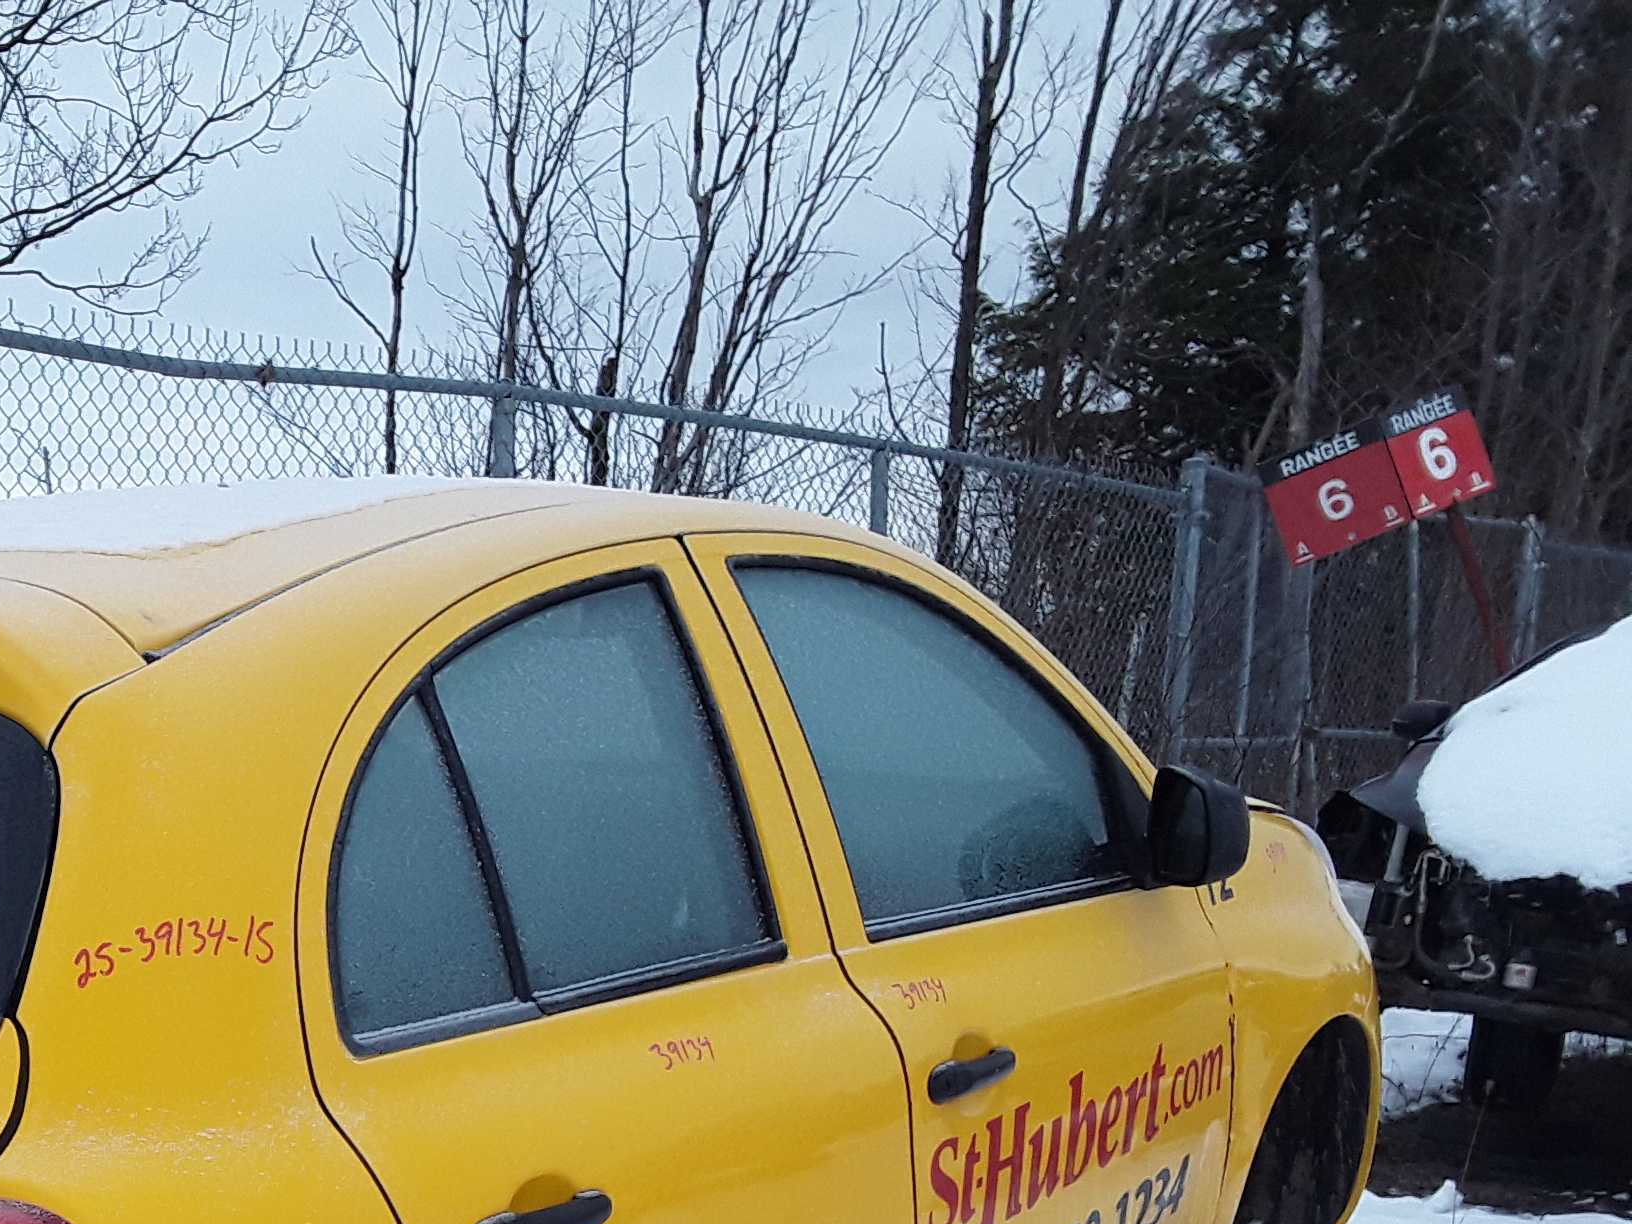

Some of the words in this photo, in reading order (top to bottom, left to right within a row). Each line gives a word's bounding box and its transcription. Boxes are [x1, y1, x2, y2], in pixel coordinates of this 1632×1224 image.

[1418, 427, 1458, 481] 6
[1318, 479, 1355, 521] 6
[73, 915, 275, 988] 25-39134-15
